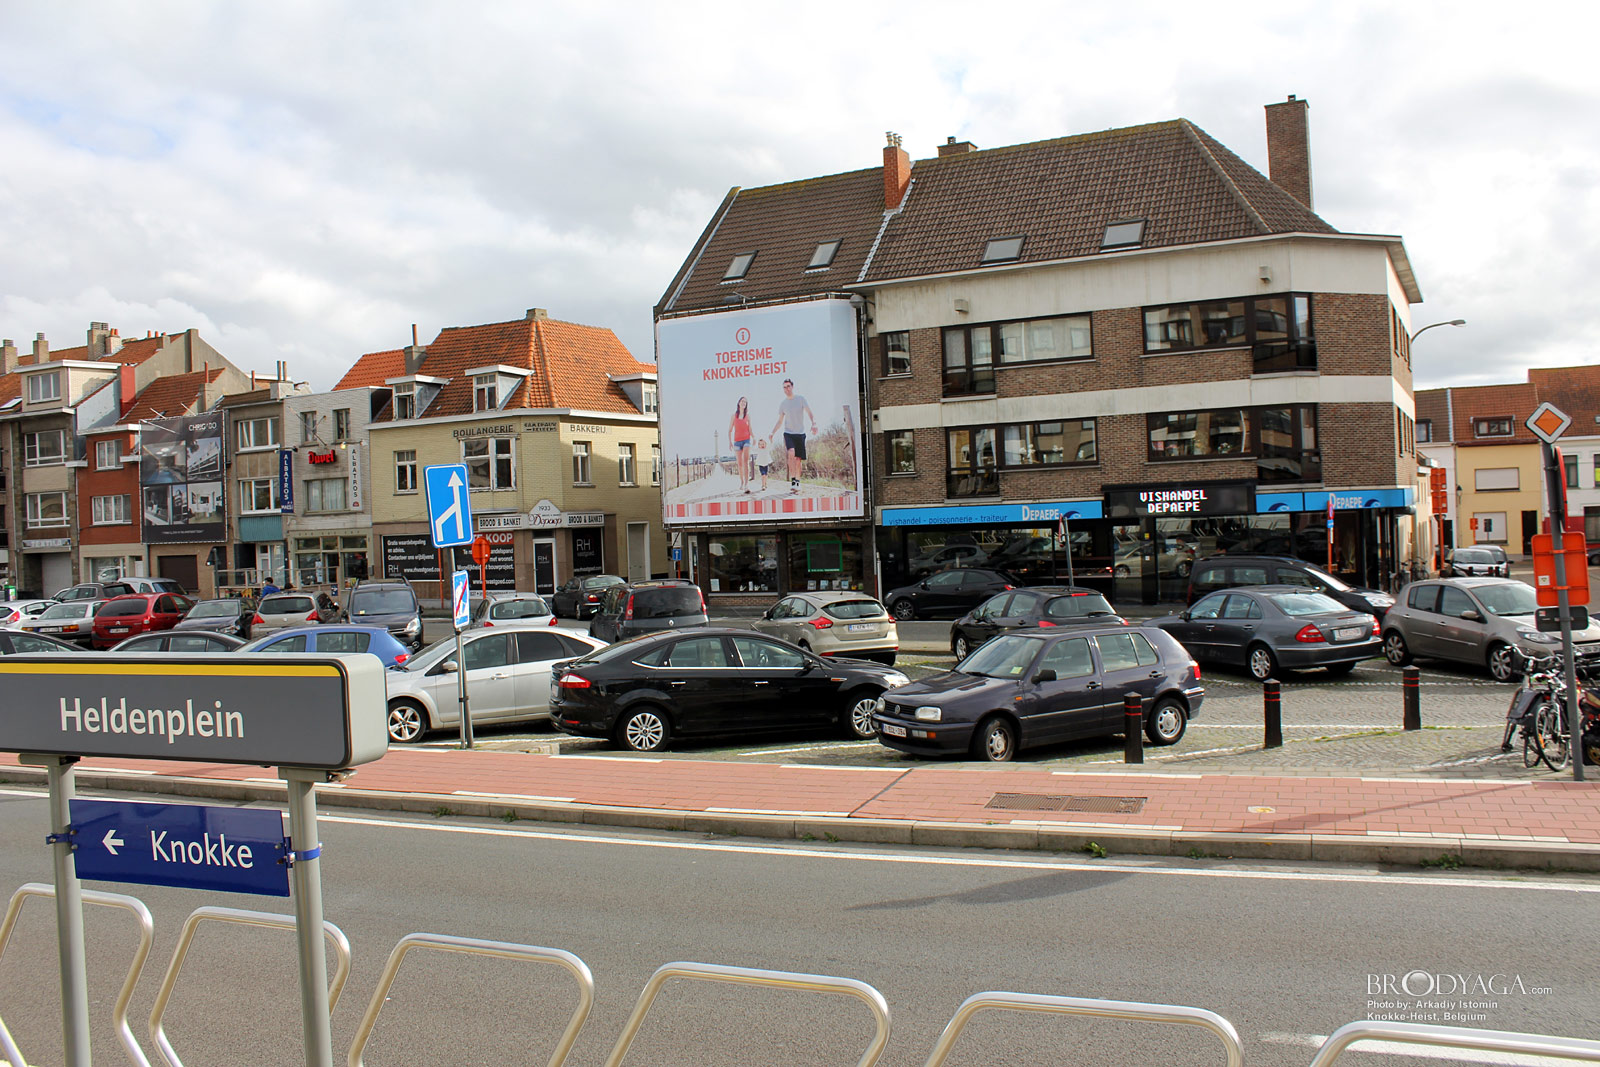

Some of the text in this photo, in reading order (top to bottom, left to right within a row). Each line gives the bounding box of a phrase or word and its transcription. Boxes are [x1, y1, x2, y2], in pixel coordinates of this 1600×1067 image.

[715, 347, 773, 364] TOERISME
[703, 361, 788, 381] KNOKKE-HEIST
[307, 449, 335, 465] Duvel
[1140, 489, 1208, 502] VISHANDEL
[1329, 492, 1363, 509] DEPAEPE
[1022, 505, 1060, 521] DEPAEPE
[1148, 501, 1201, 514] DEPAEPE
[480, 517, 496, 527] BROOD
[503, 516, 521, 526] BANKET
[568, 515, 582, 524] BROOD
[588, 514, 603, 523] BANKET
[889, 517, 921, 526] vishandel
[929, 516, 973, 525] poissonnerie
[980, 515, 1008, 523] traiteur
[486, 533, 513, 543] KOOP
[577, 539, 591, 551] RH
[388, 564, 399, 573] RH
[60, 697, 245, 744] Heldenplein
[151, 829, 254, 869] Knokke
